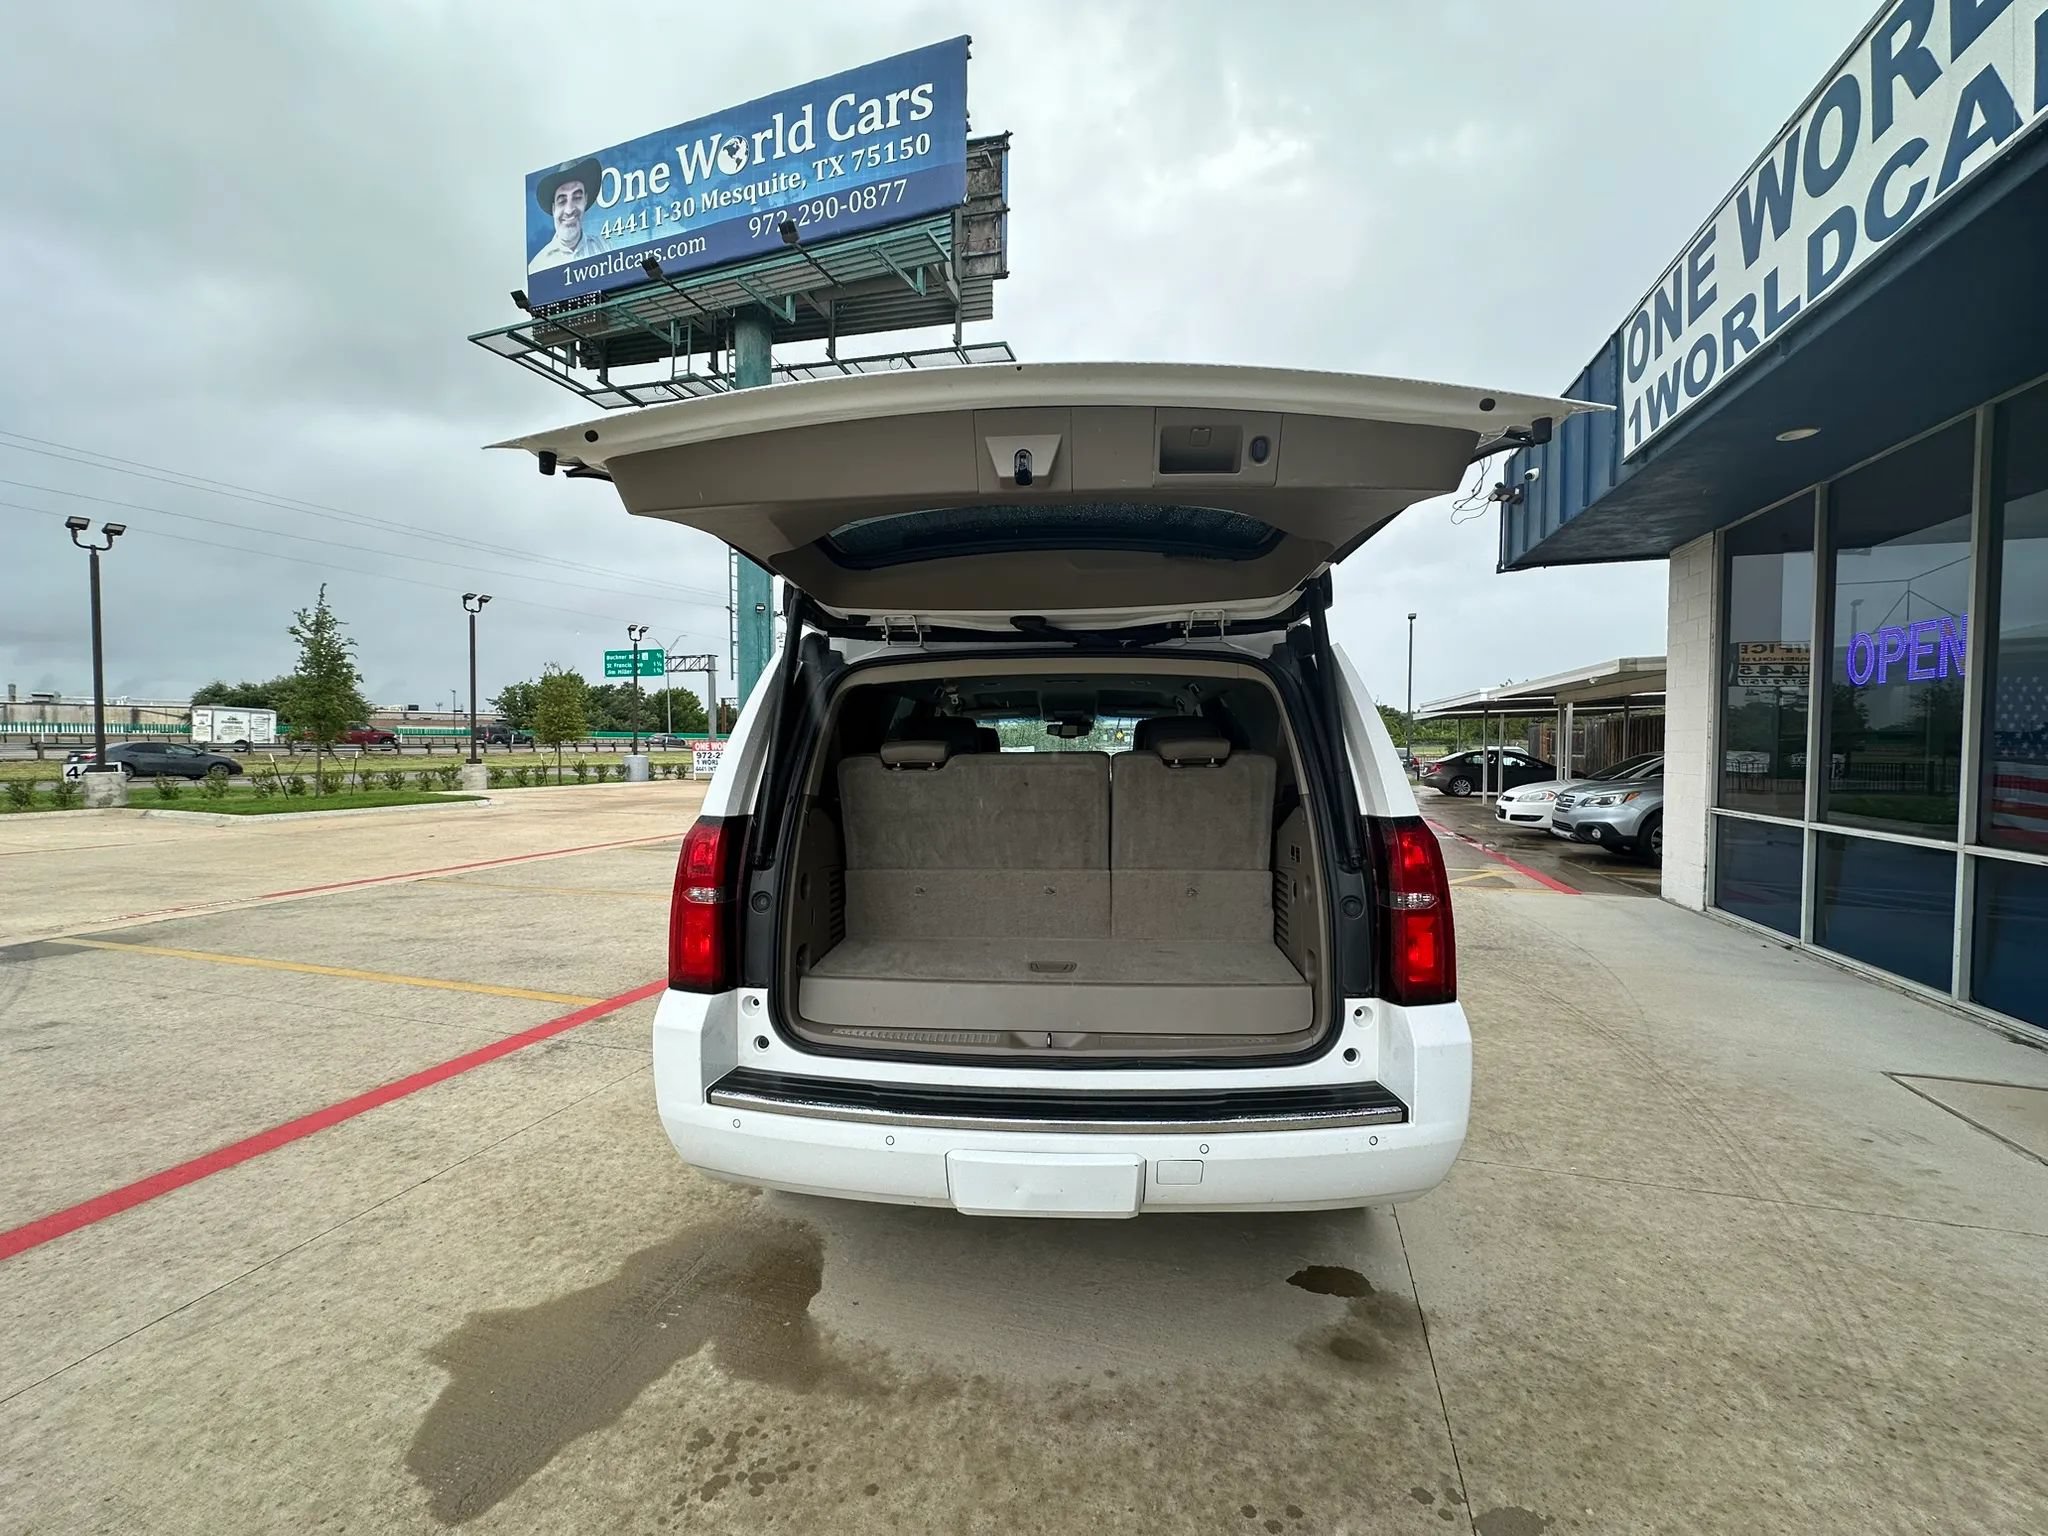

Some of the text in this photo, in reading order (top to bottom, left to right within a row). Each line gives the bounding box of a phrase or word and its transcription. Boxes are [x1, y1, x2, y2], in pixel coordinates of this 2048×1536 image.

[596, 162, 671, 209] One
[826, 82, 934, 142] Cars
[600, 133, 932, 240] 4441 I-30 Mesquite, TX 75150
[748, 179, 908, 238] 972-290-0877
[563, 235, 707, 286] 1worldcars.com
[1625, 224, 1718, 383] ONE
[1847, 614, 1968, 685] OPEN
[694, 742, 710, 751] ONE
